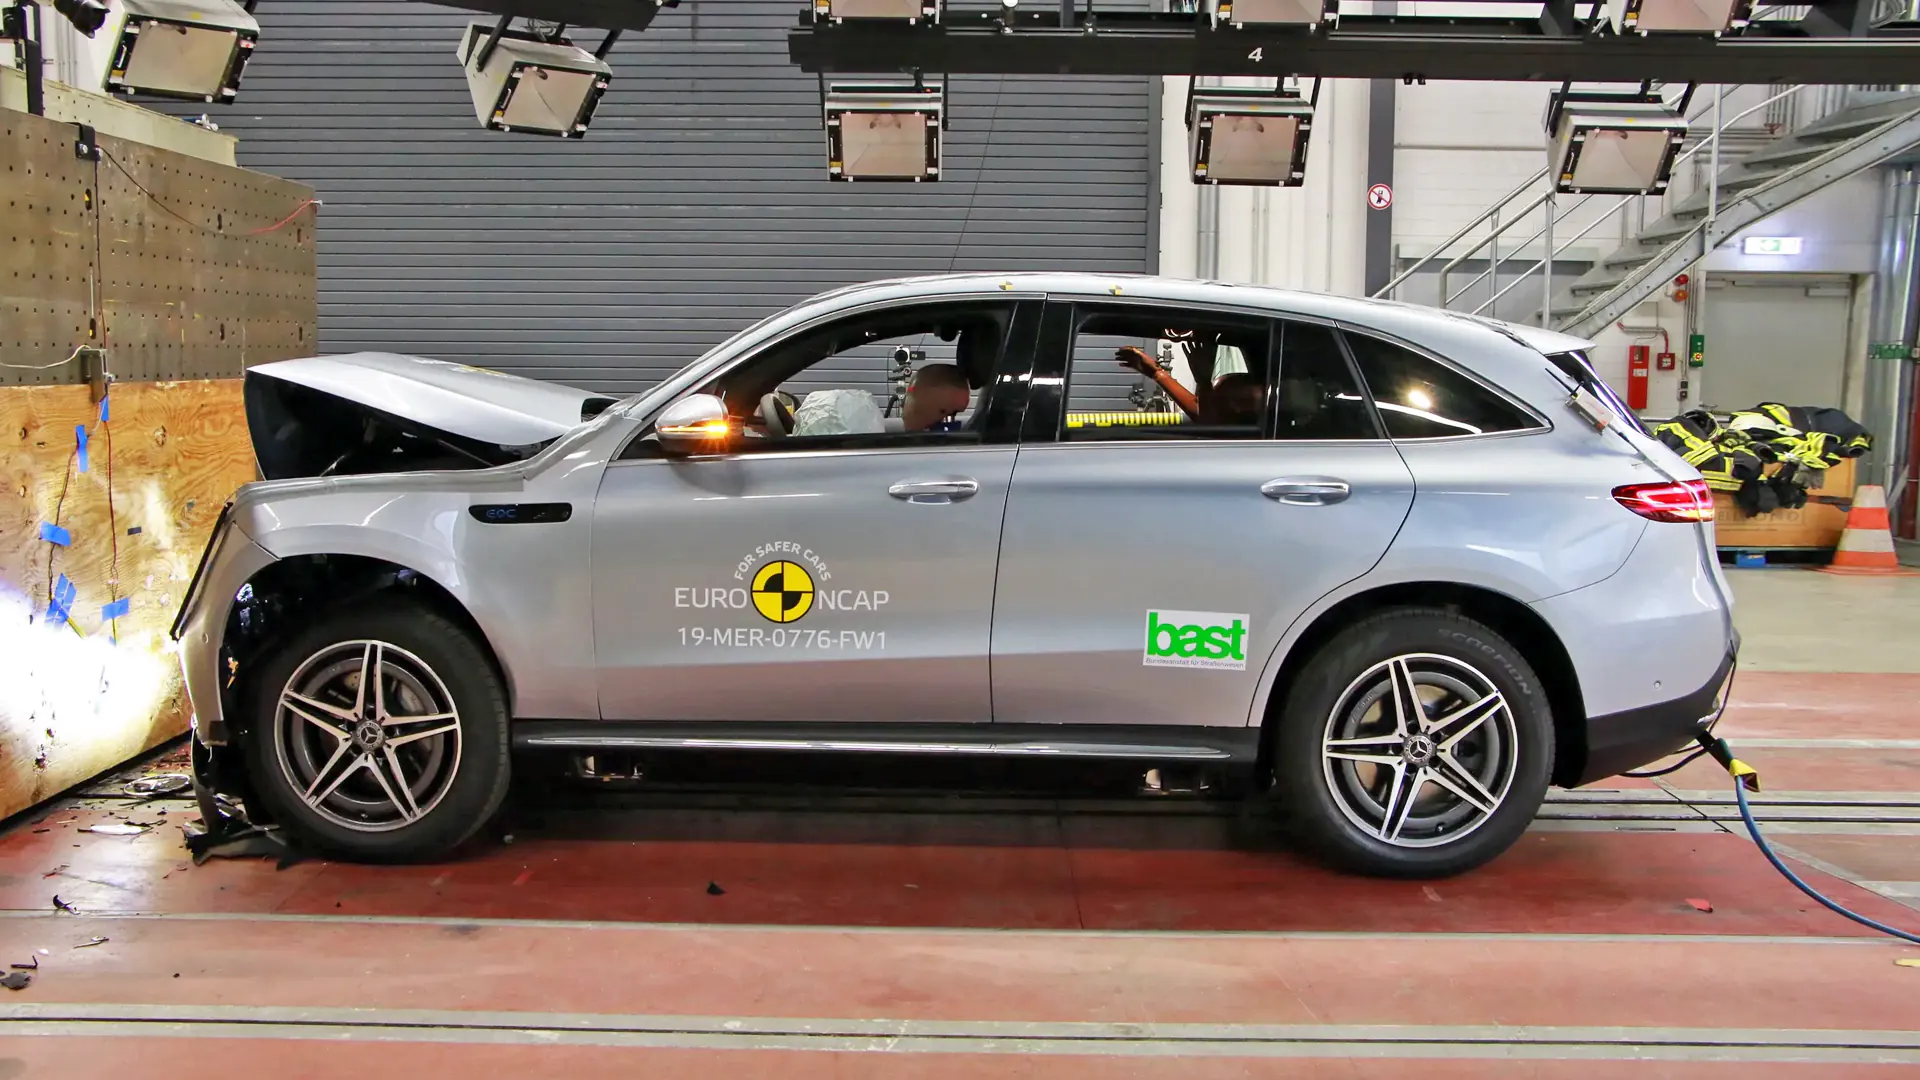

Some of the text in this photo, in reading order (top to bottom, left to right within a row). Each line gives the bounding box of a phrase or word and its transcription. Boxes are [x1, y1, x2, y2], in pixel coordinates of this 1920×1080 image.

[1247, 47, 1263, 62] 4
[734, 541, 832, 582] FOR SAFER CARS
[674, 587, 890, 611] EURO NCAP
[677, 627, 887, 650] 19-MER-0776-FW1
[1147, 612, 1246, 660] bast
